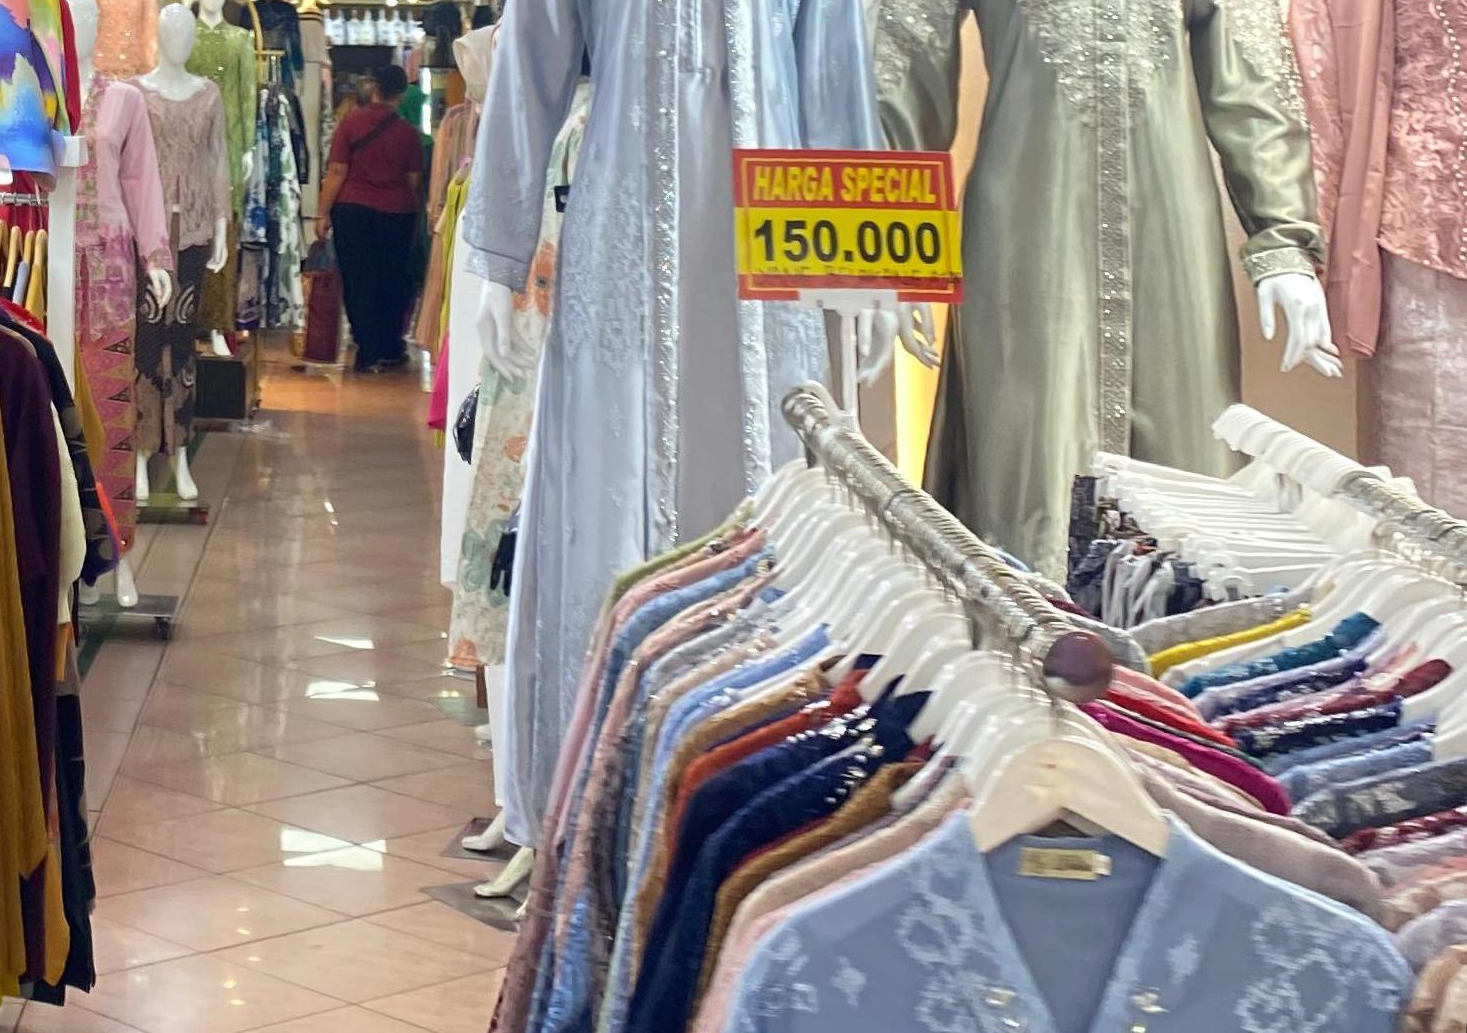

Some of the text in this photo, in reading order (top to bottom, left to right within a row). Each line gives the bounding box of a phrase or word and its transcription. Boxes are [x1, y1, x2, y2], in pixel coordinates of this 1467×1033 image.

[753, 166, 936, 204] HARGA SPECIAL
[754, 218, 941, 265] 150.000
